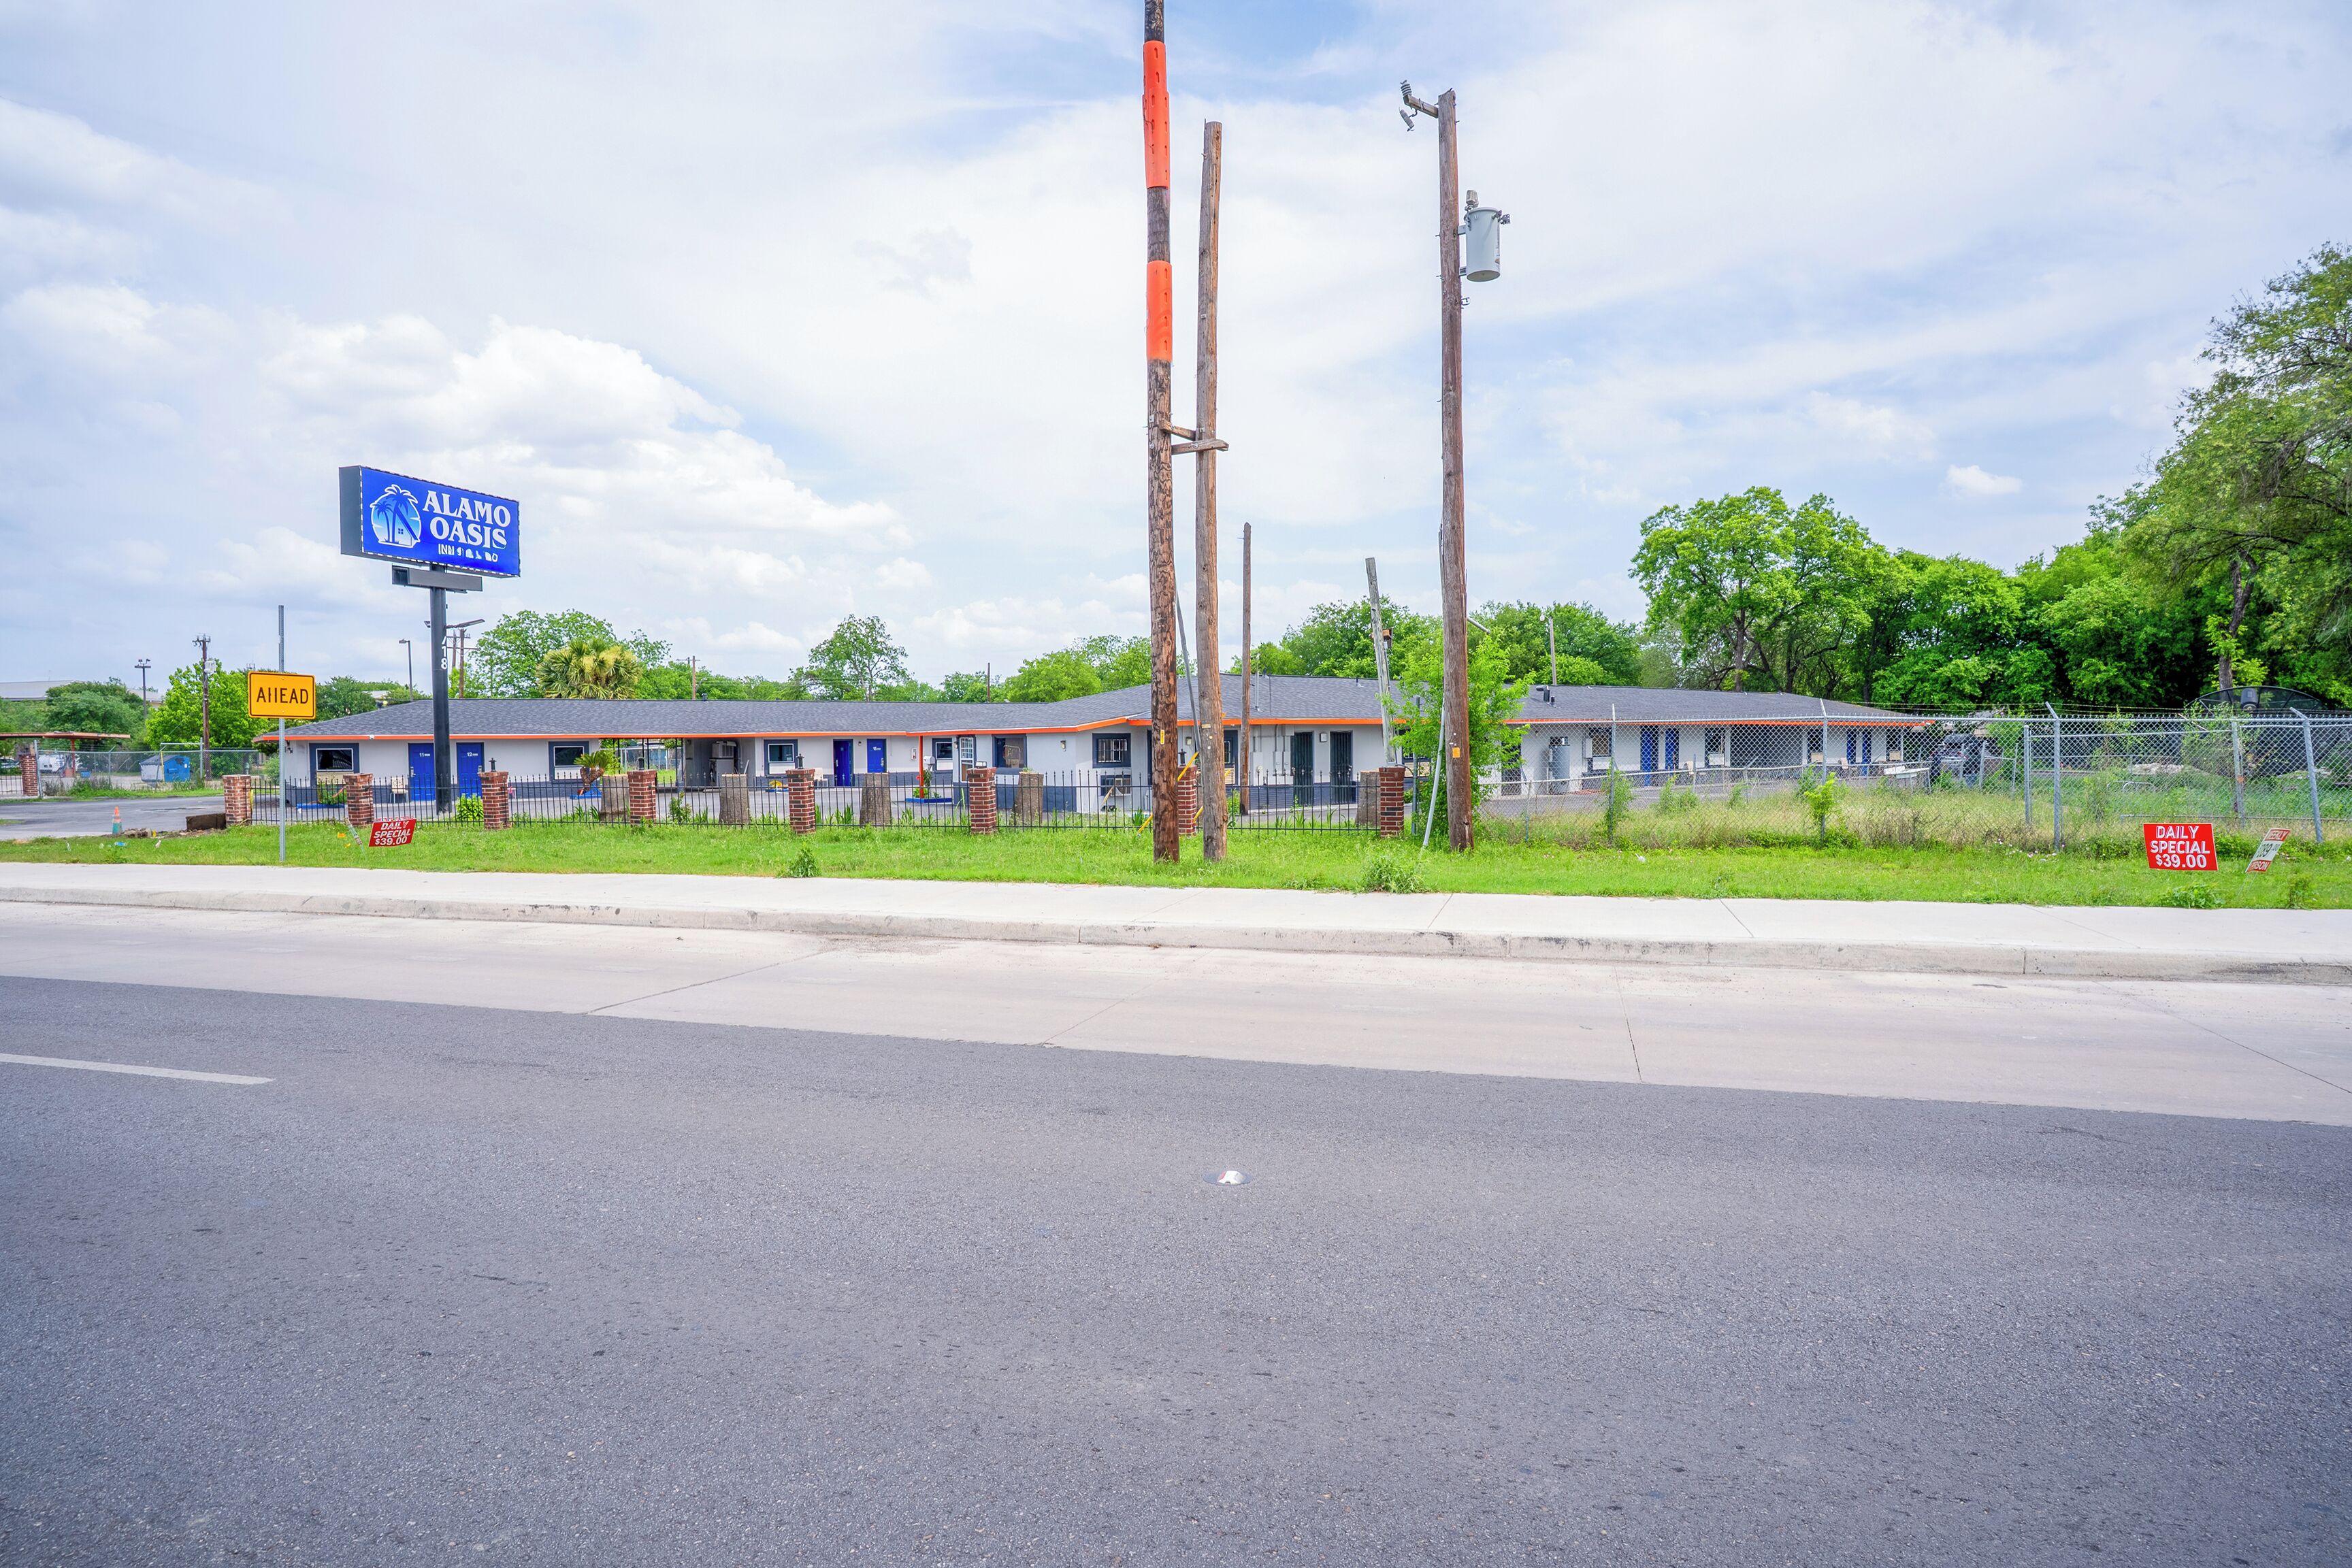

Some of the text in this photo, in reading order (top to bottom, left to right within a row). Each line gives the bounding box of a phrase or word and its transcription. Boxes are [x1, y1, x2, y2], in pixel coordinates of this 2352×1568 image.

[422, 490, 510, 527] ALAMO
[430, 517, 508, 550] OASIS
[381, 821, 409, 830] DAILY
[374, 829, 411, 838] SPECIAL
[2156, 826, 2200, 838] DAILY
[375, 836, 408, 845] $39.00
[2151, 840, 2210, 853] SPECIAL
[2155, 854, 2207, 868] $39.00
